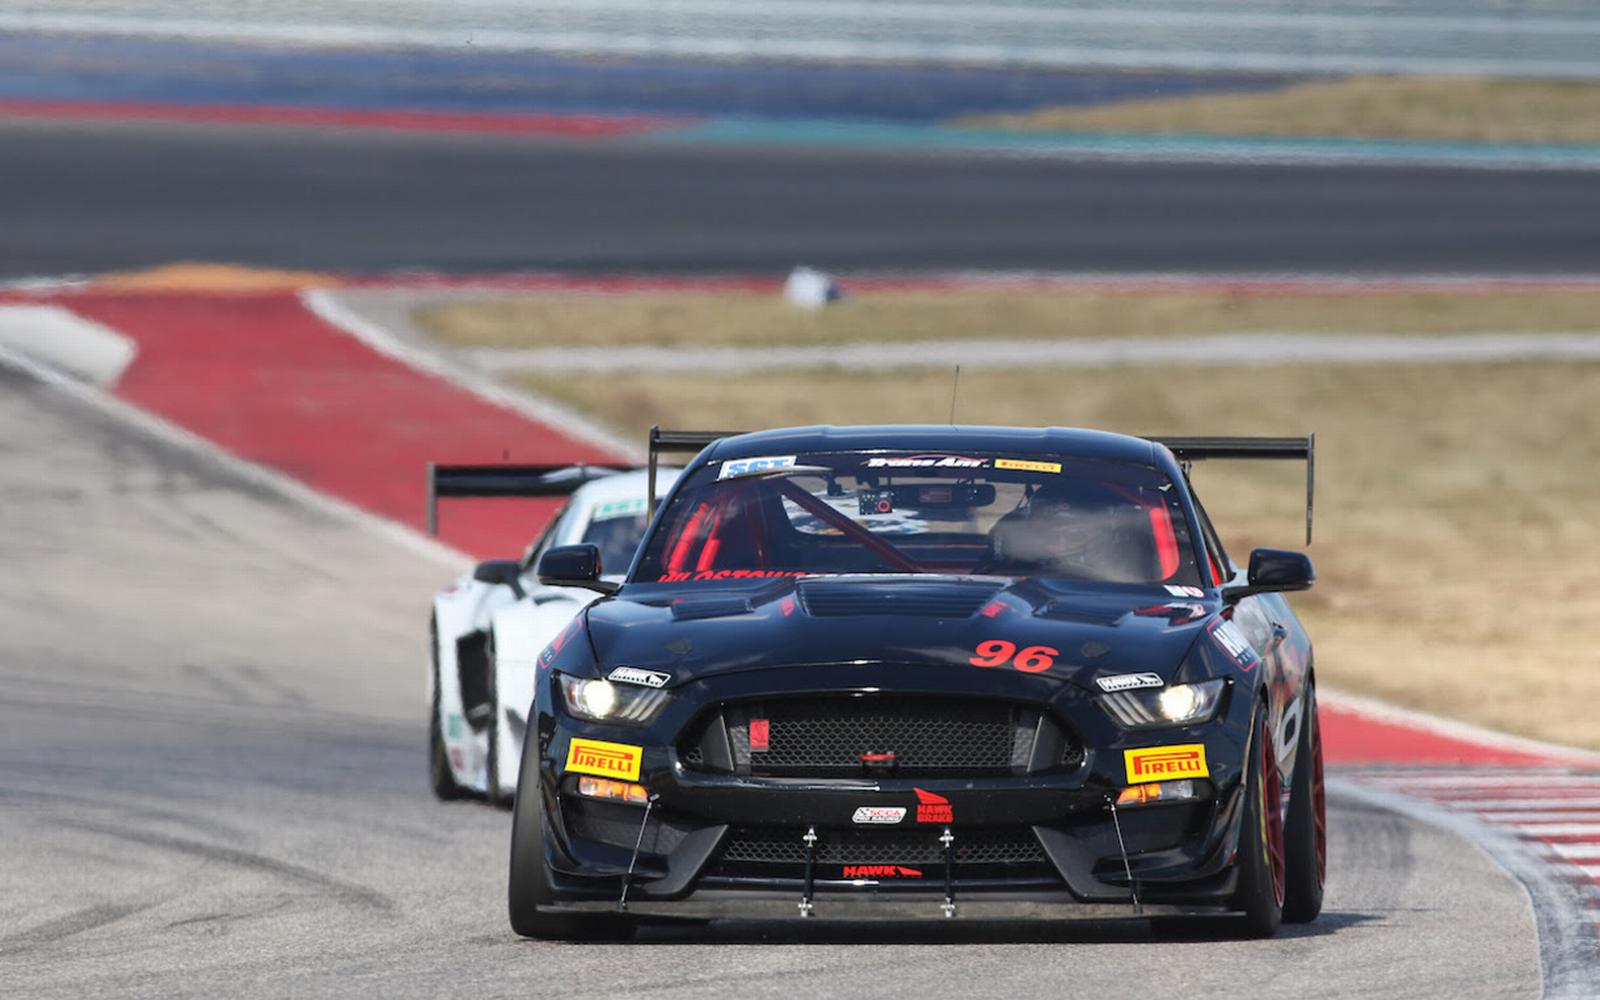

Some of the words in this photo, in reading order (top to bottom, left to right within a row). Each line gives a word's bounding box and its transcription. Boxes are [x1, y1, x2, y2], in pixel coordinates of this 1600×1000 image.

[969, 640, 1060, 673] 96
[572, 745, 633, 773] PIRELLI
[1133, 751, 1201, 776] PIRELLI
[843, 866, 897, 877] HAWK
